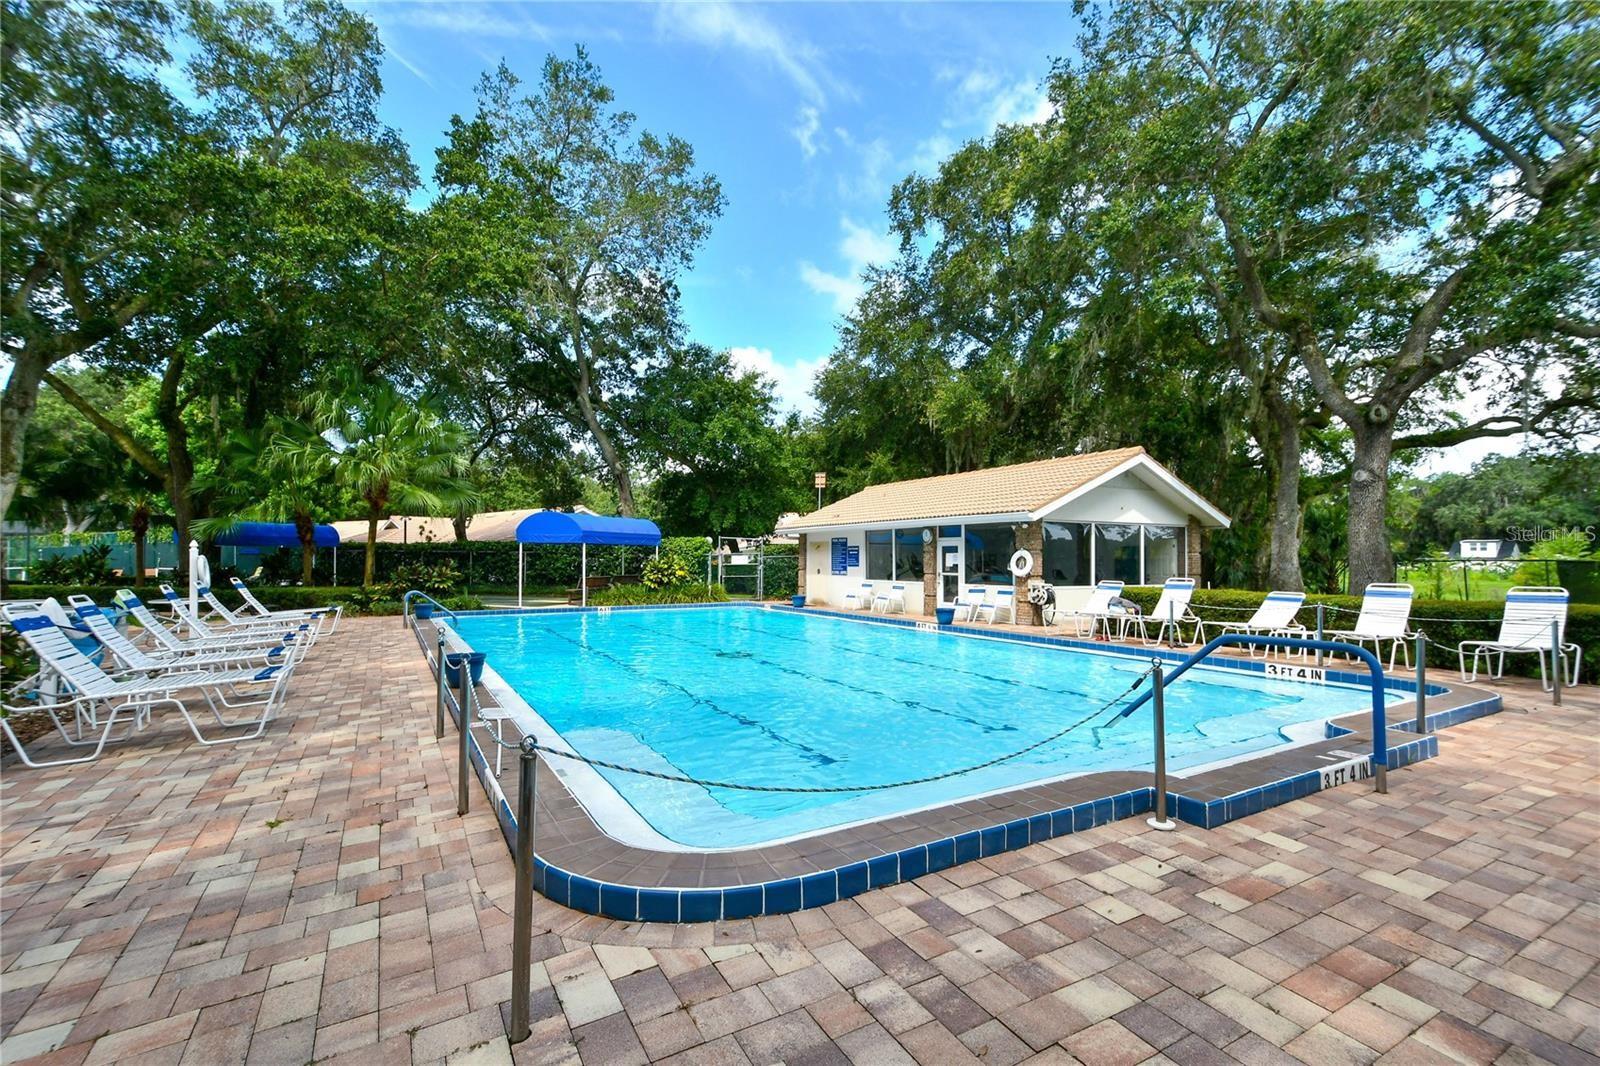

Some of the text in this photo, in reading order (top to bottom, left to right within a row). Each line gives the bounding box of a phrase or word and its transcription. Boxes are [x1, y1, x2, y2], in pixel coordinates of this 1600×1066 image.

[1268, 664, 1322, 681] 3 FT 4 IN
[1324, 761, 1370, 789] 3 FT 4 IN
